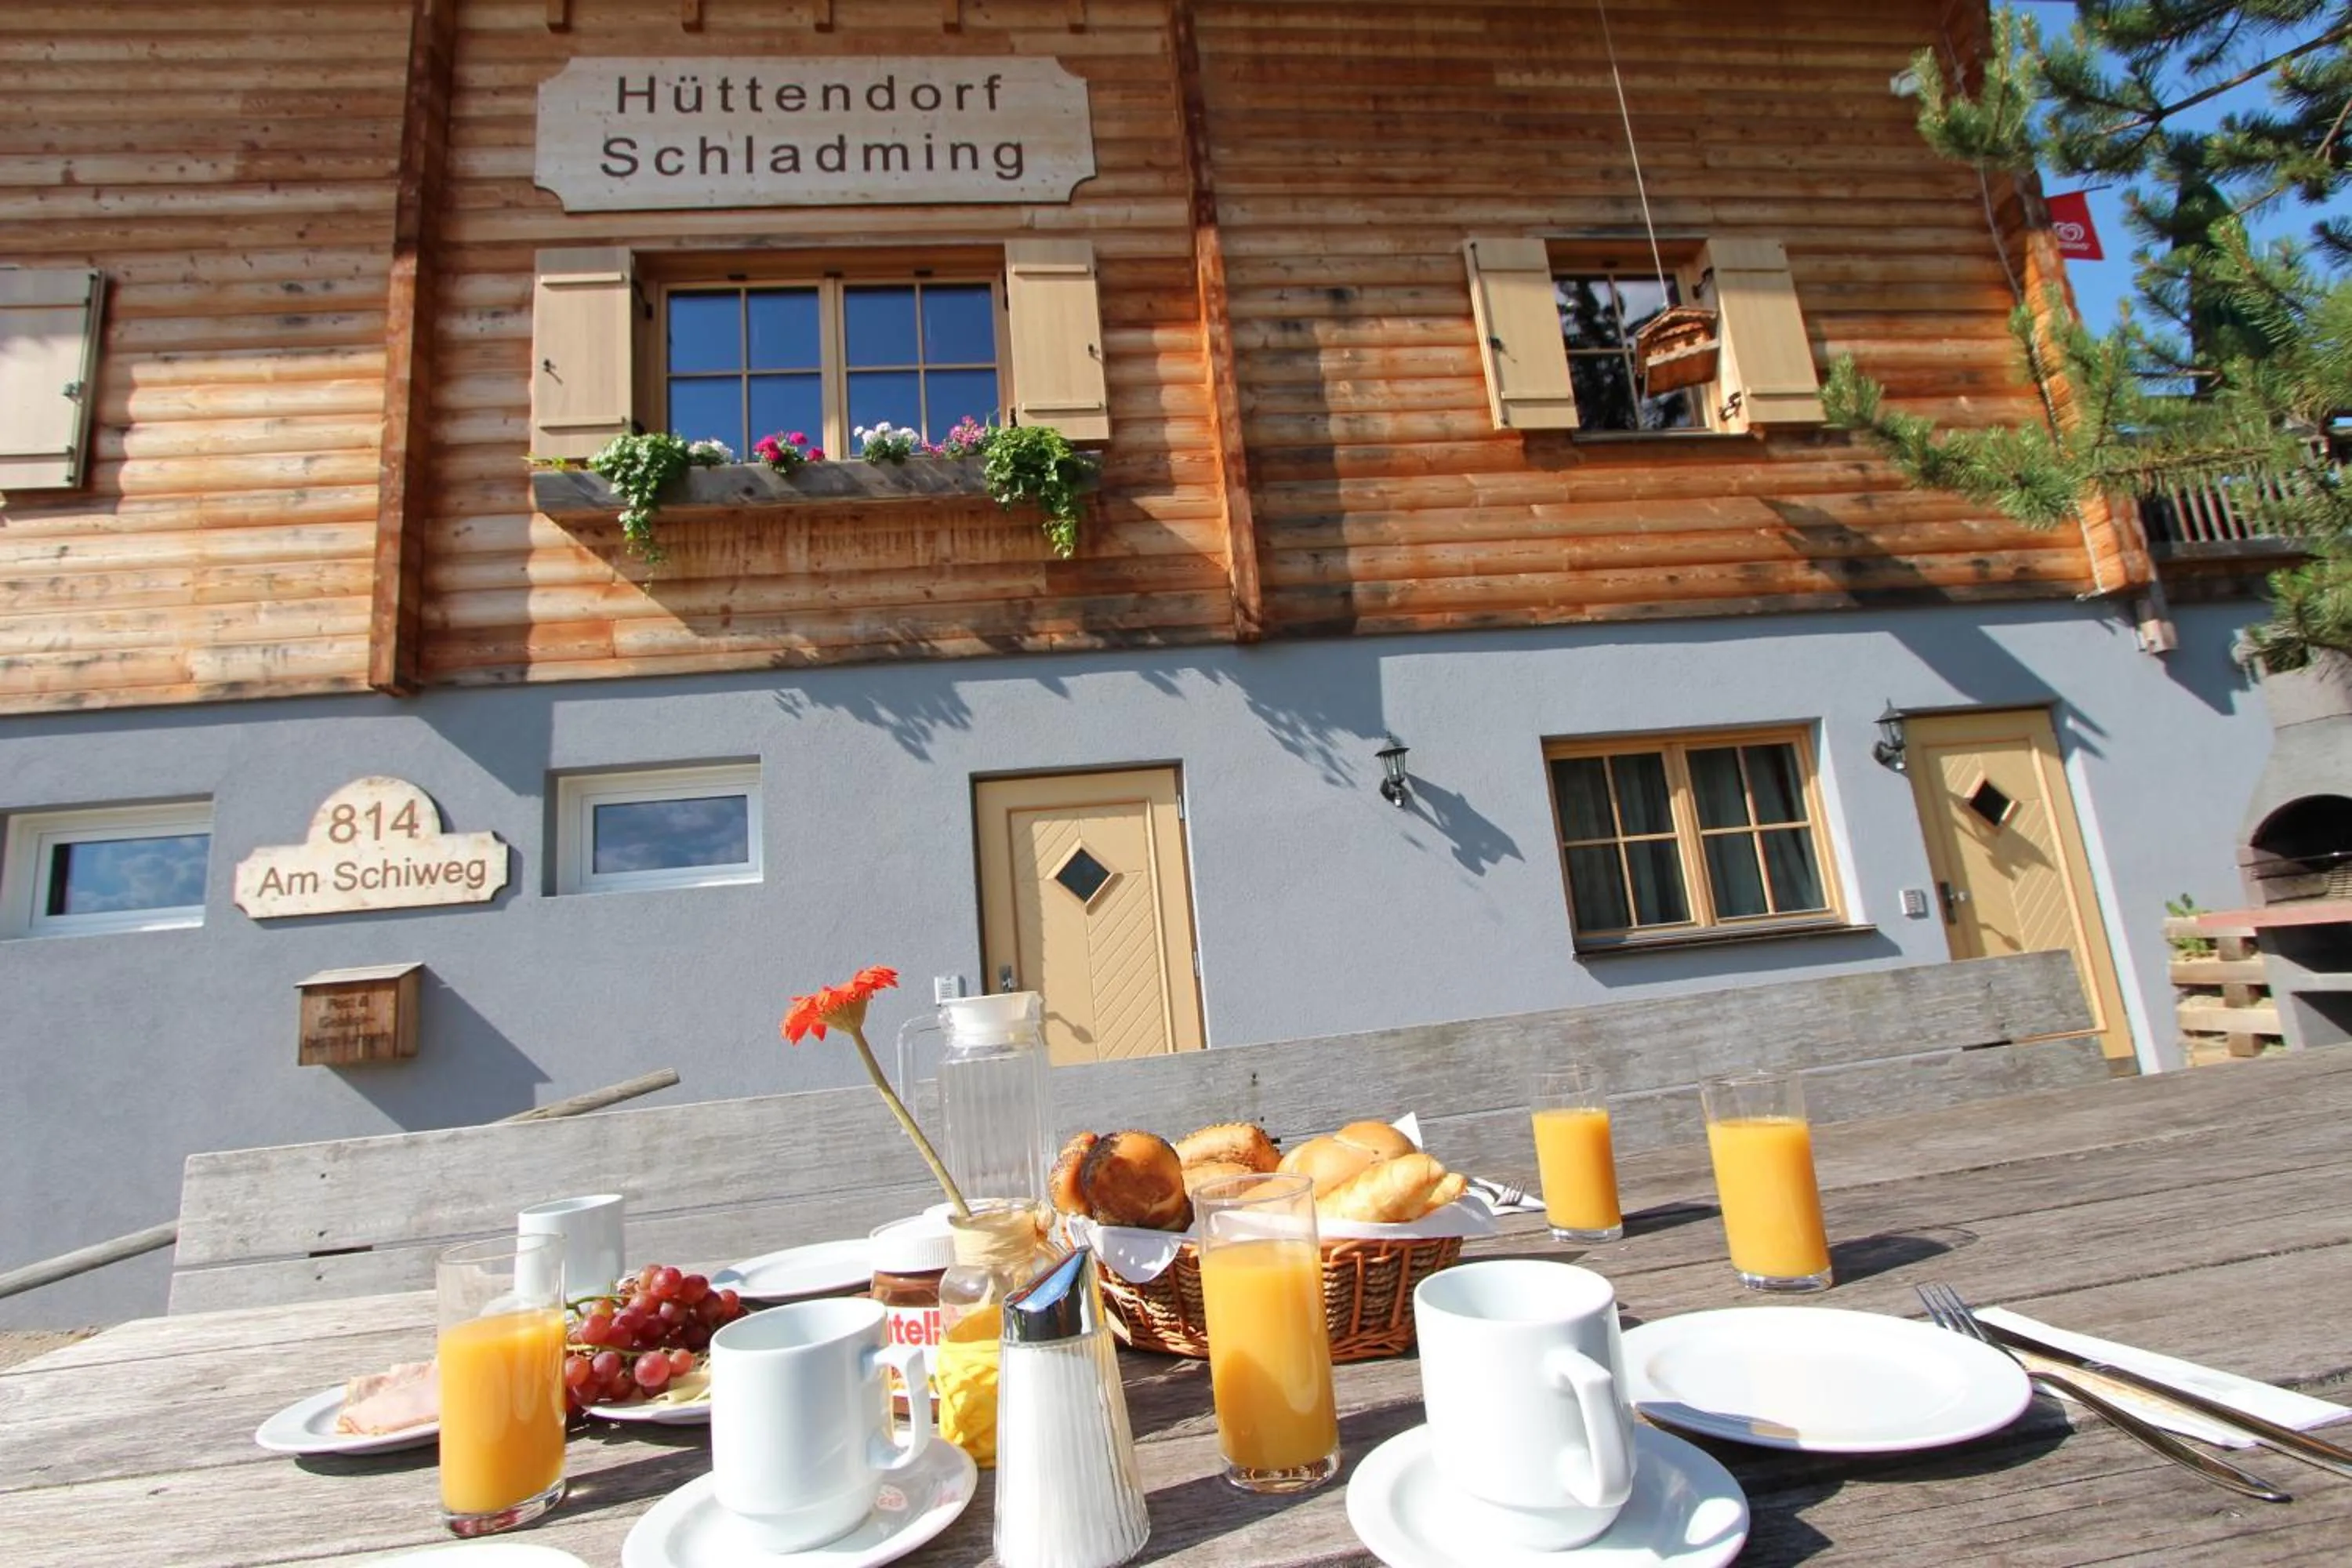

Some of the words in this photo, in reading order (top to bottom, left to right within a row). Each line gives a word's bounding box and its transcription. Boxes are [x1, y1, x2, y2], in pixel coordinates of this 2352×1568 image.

[616, 74, 1002, 114] Hüttendorf
[600, 133, 1025, 180] Schladming
[328, 799, 419, 844] 814
[256, 866, 318, 898] Am
[333, 857, 487, 891] Schiweg
